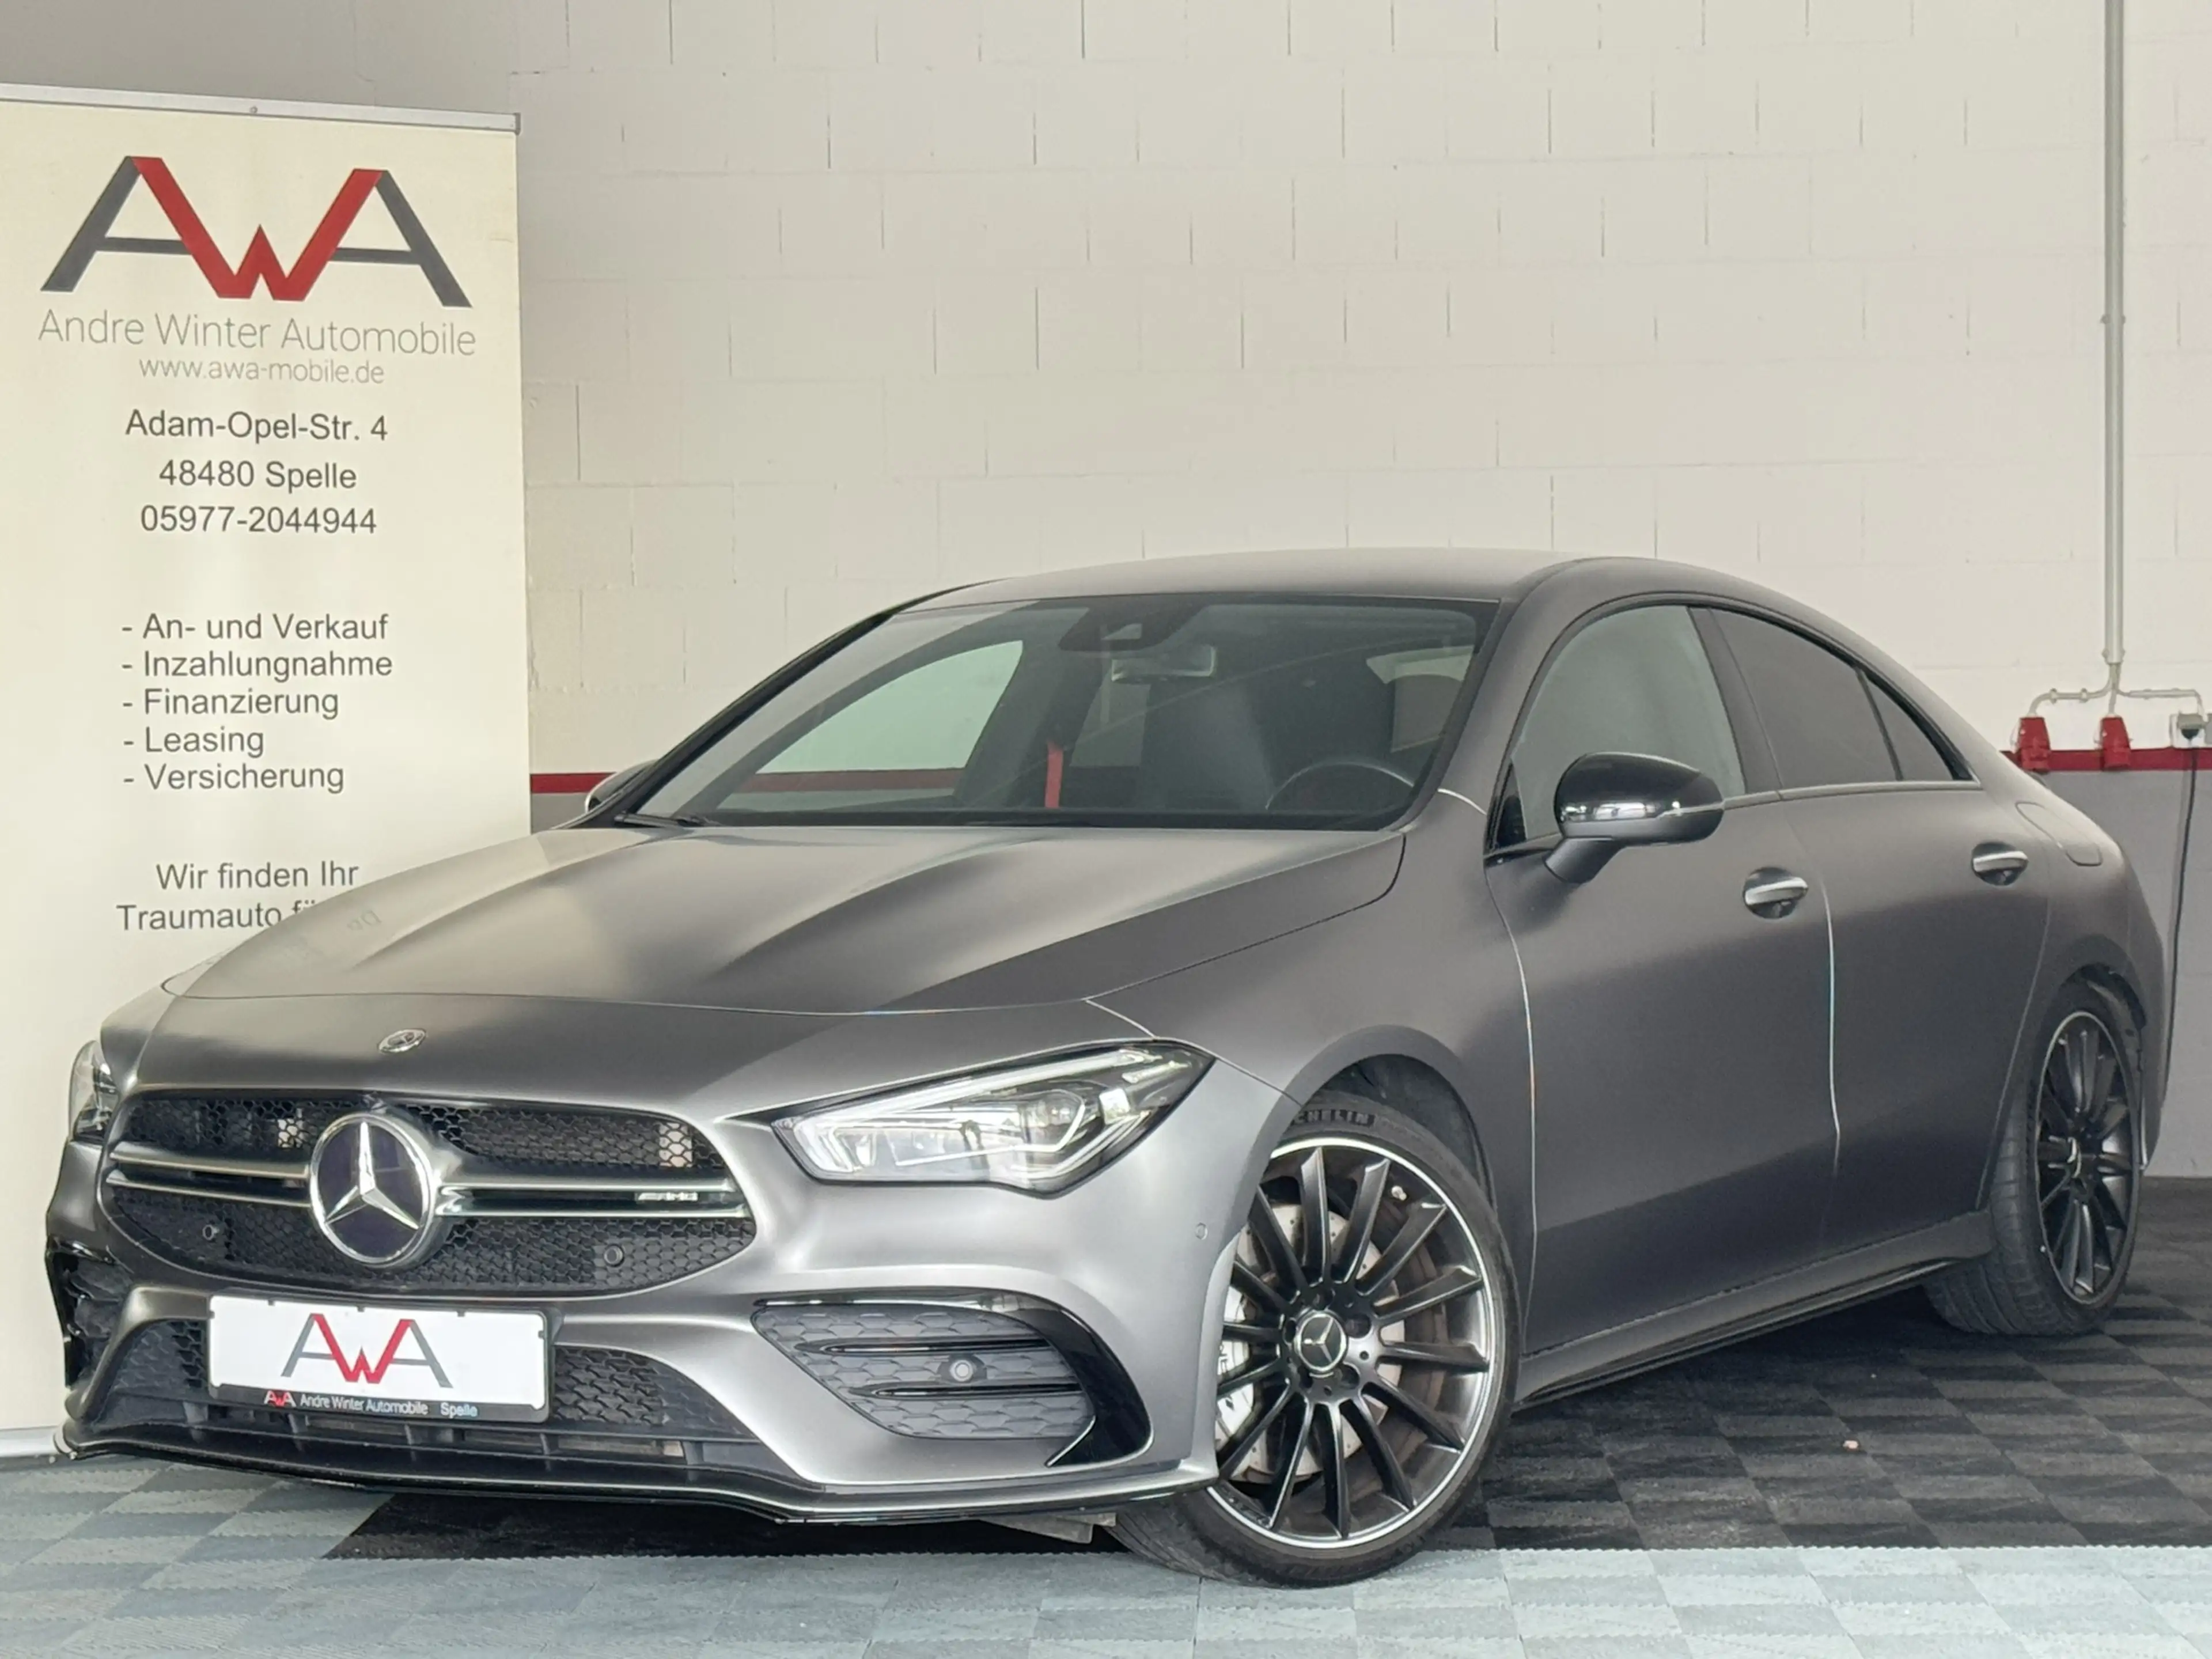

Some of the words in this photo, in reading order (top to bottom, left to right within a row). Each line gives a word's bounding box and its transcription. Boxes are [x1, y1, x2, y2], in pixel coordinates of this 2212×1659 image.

[40, 155, 472, 308] AWA
[37, 308, 145, 346] Andre
[154, 312, 271, 349] Winter
[281, 317, 476, 357] Automobile
[138, 357, 385, 384] www.awa-mobile.de
[124, 408, 360, 445] Adam-Opel-Str.
[370, 415, 388, 442] 4
[158, 459, 255, 488] 48480
[265, 460, 358, 495] Spelle
[141, 504, 377, 535] 05977-2044944
[142, 613, 196, 640] An-
[207, 612, 262, 640] und
[272, 612, 389, 640] Verkauf
[143, 650, 393, 683] Inzahlungnahme
[144, 687, 339, 721] Finanzierung
[145, 725, 264, 759] Leasing
[143, 762, 344, 794] Versicherung
[155, 863, 209, 890] Wir
[217, 861, 309, 889] finden
[320, 860, 359, 887] Ihr
[116, 901, 282, 931] Traumauto
[280, 1313, 454, 1388] AWA
[300, 1393, 330, 1409] Andre
[330, 1396, 364, 1411] Winter
[365, 1399, 429, 1416] Automobile
[440, 1402, 478, 1418] Spelle
